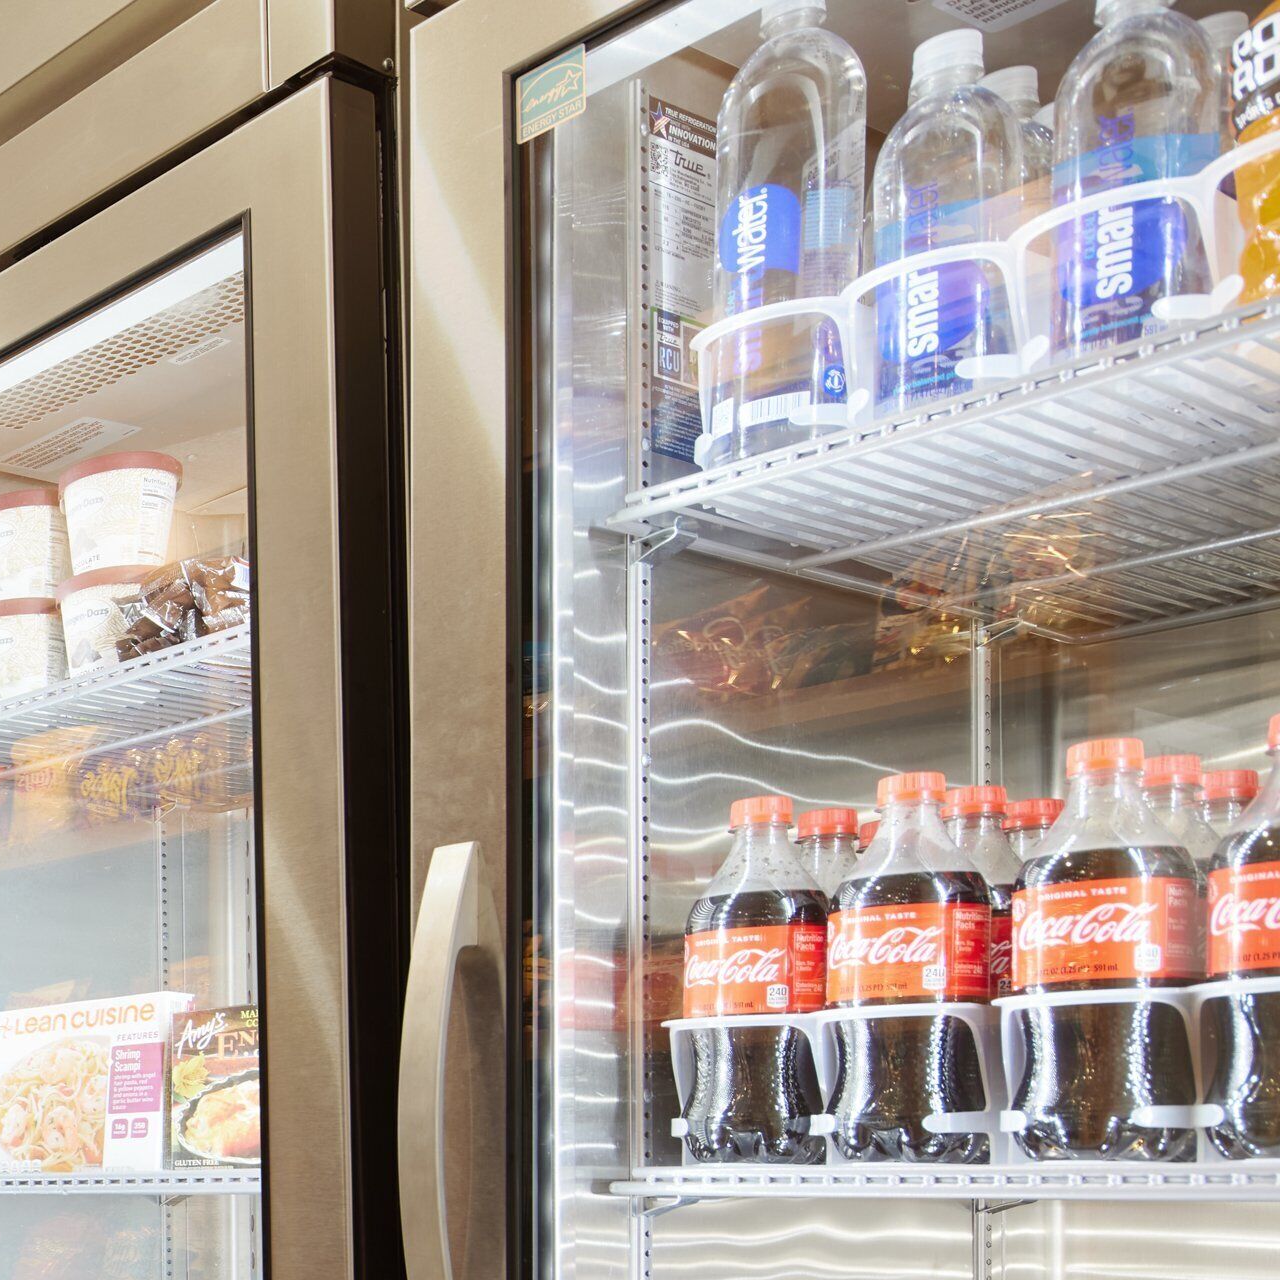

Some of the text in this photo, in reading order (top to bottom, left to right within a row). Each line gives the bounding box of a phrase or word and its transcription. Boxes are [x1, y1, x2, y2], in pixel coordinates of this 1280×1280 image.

[522, 100, 582, 138] ENERGY STAR
[669, 125, 716, 151] INNOVATION
[1096, 205, 1133, 300] smar
[907, 270, 939, 358] smar
[1091, 886, 1128, 897] TASTE
[885, 911, 918, 920] TASTE
[1018, 902, 1159, 951] Coca-Cola
[732, 934, 761, 944] TASTE
[796, 942, 817, 952] Facts
[828, 926, 944, 970] Coca-Cola
[685, 948, 786, 987] Coca-Cola
[1093, 963, 1106, 972] 591
[768, 986, 788, 997] 240
[15, 1006, 67, 1035] Lean
[116, 1030, 160, 1042] FEATURES
[174, 1011, 229, 1060] Amy's
[115, 1049, 141, 1062] Shrimp
[114, 1061, 141, 1073] Scampi
[142, 1072, 156, 1080] angel
[174, 1159, 219, 1167] GLUTEN FREE
